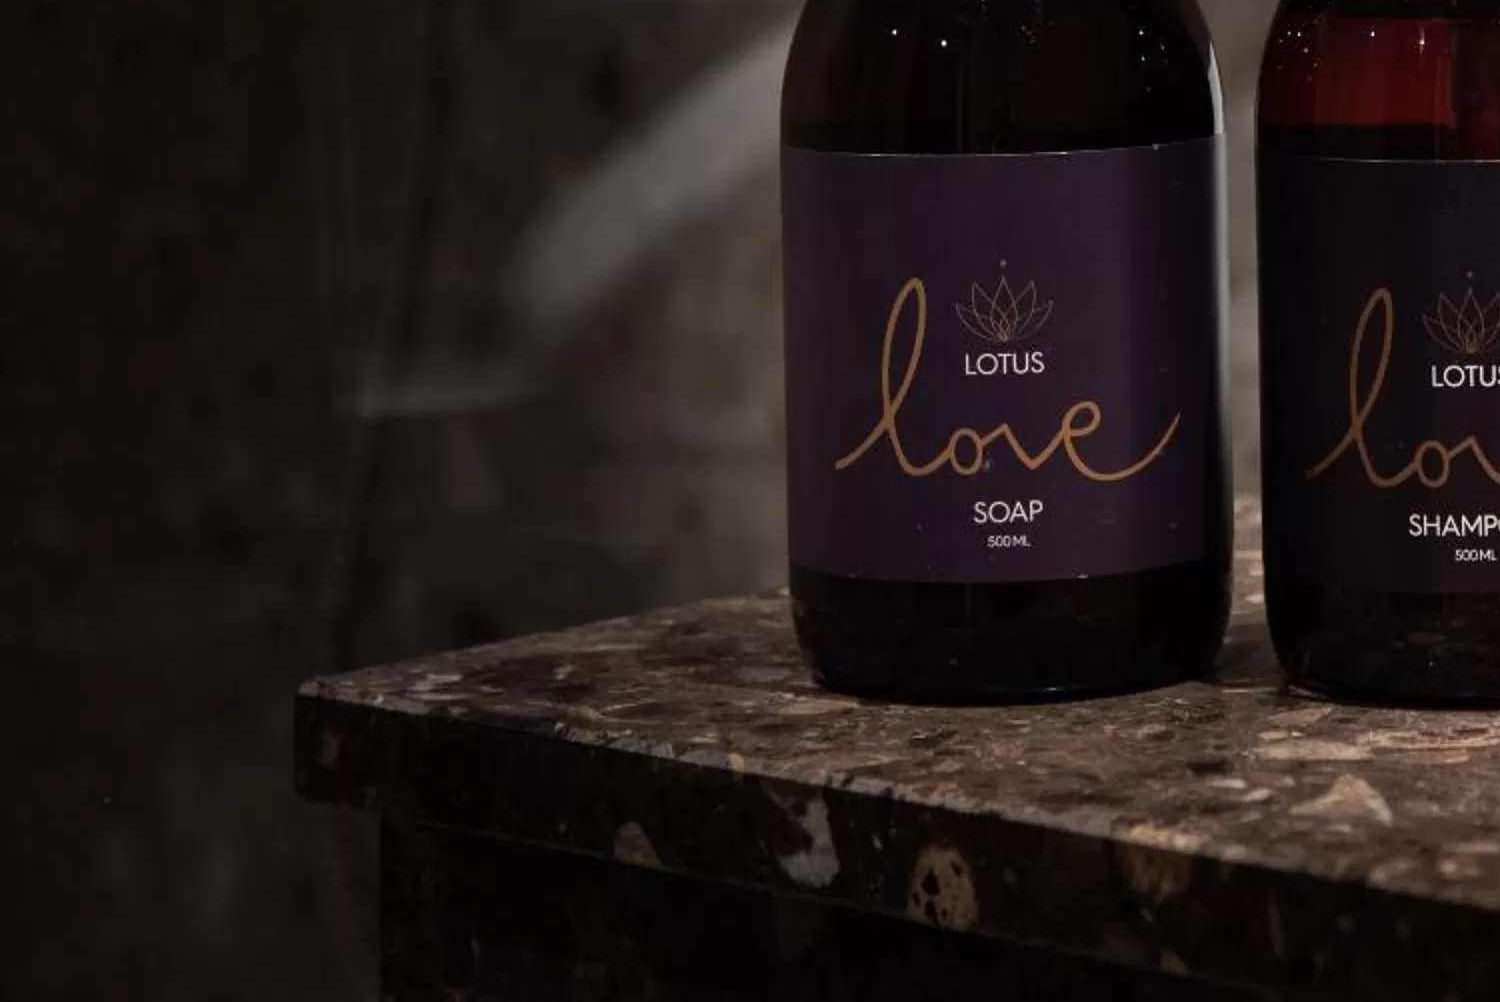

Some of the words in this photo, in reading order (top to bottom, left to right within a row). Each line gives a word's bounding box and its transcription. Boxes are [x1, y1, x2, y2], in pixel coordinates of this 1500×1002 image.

[965, 352, 1046, 375] LOTUS
[835, 278, 1181, 482] love
[973, 500, 1044, 524] SOAP
